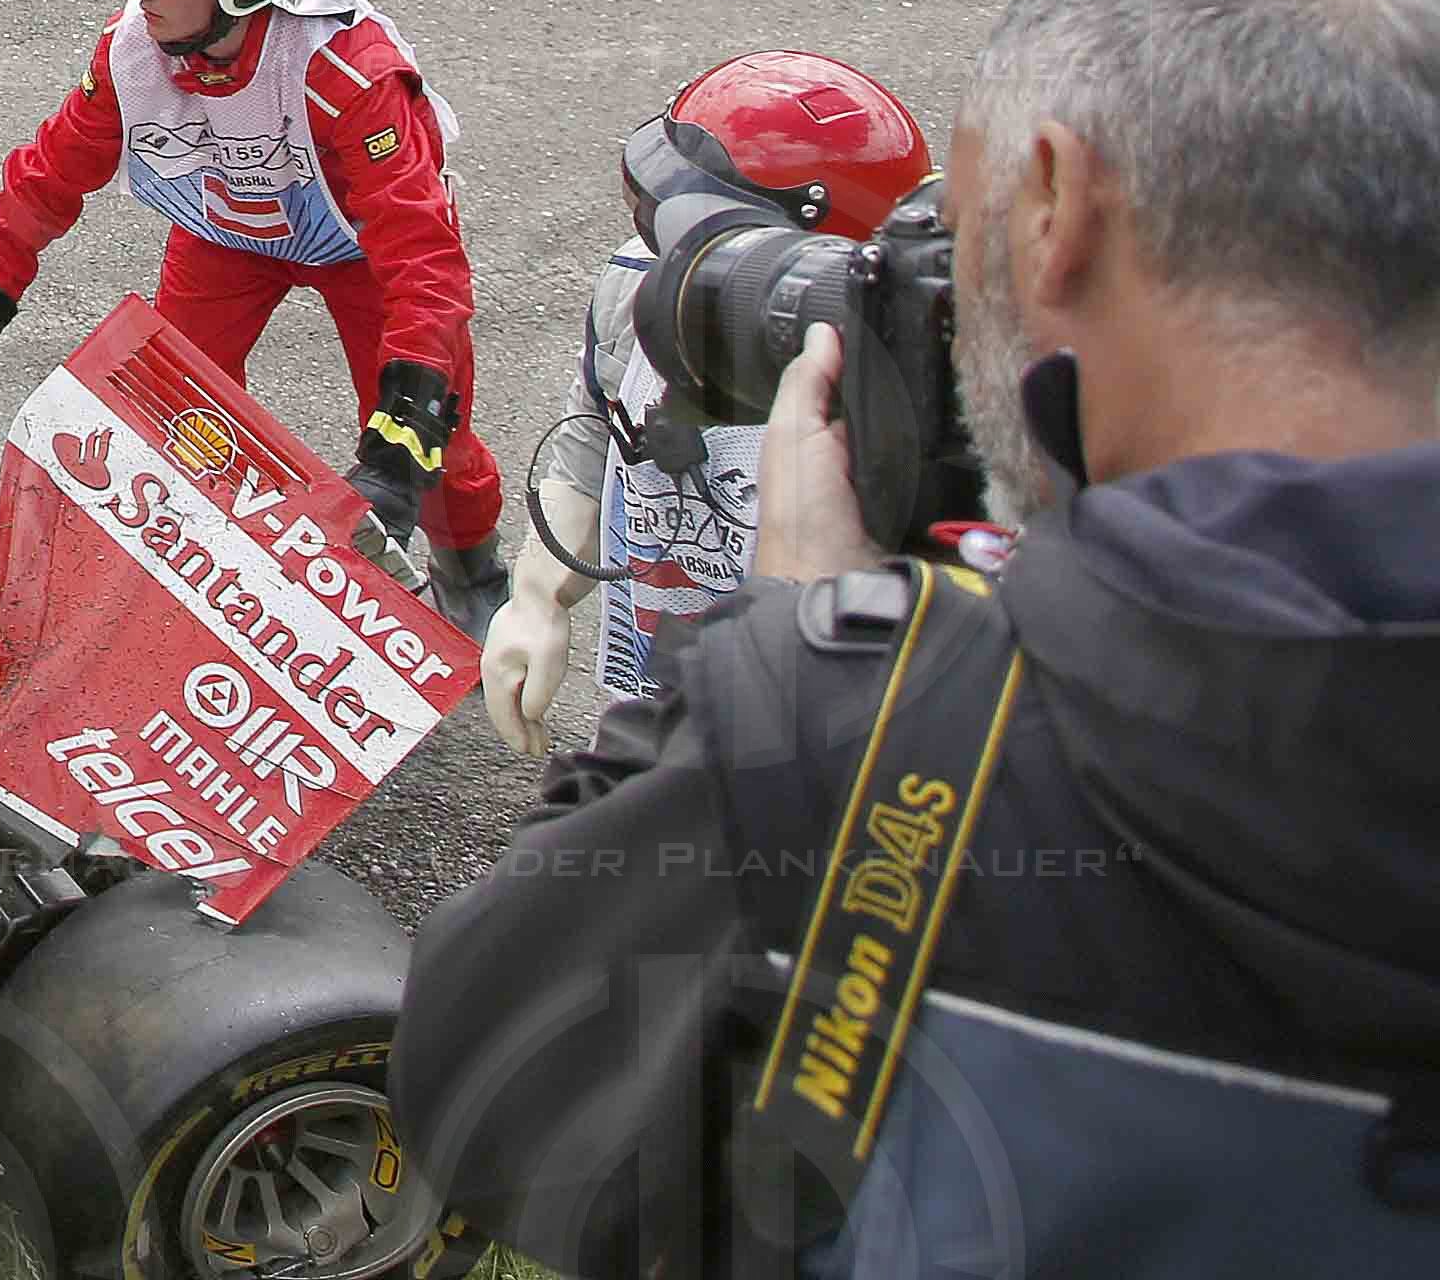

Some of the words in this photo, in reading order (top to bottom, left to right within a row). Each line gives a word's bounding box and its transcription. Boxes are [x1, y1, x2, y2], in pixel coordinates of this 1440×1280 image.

[222, 145, 264, 161] 155
[228, 174, 276, 189] ARSHAL
[367, 133, 398, 155] OMP
[104, 473, 396, 749] Santander
[229, 466, 454, 686] V-Power
[673, 553, 732, 580] ARSHAL
[46, 727, 252, 881] telcel
[138, 710, 288, 856] MAHLE
[793, 935, 892, 1119] Nikon
